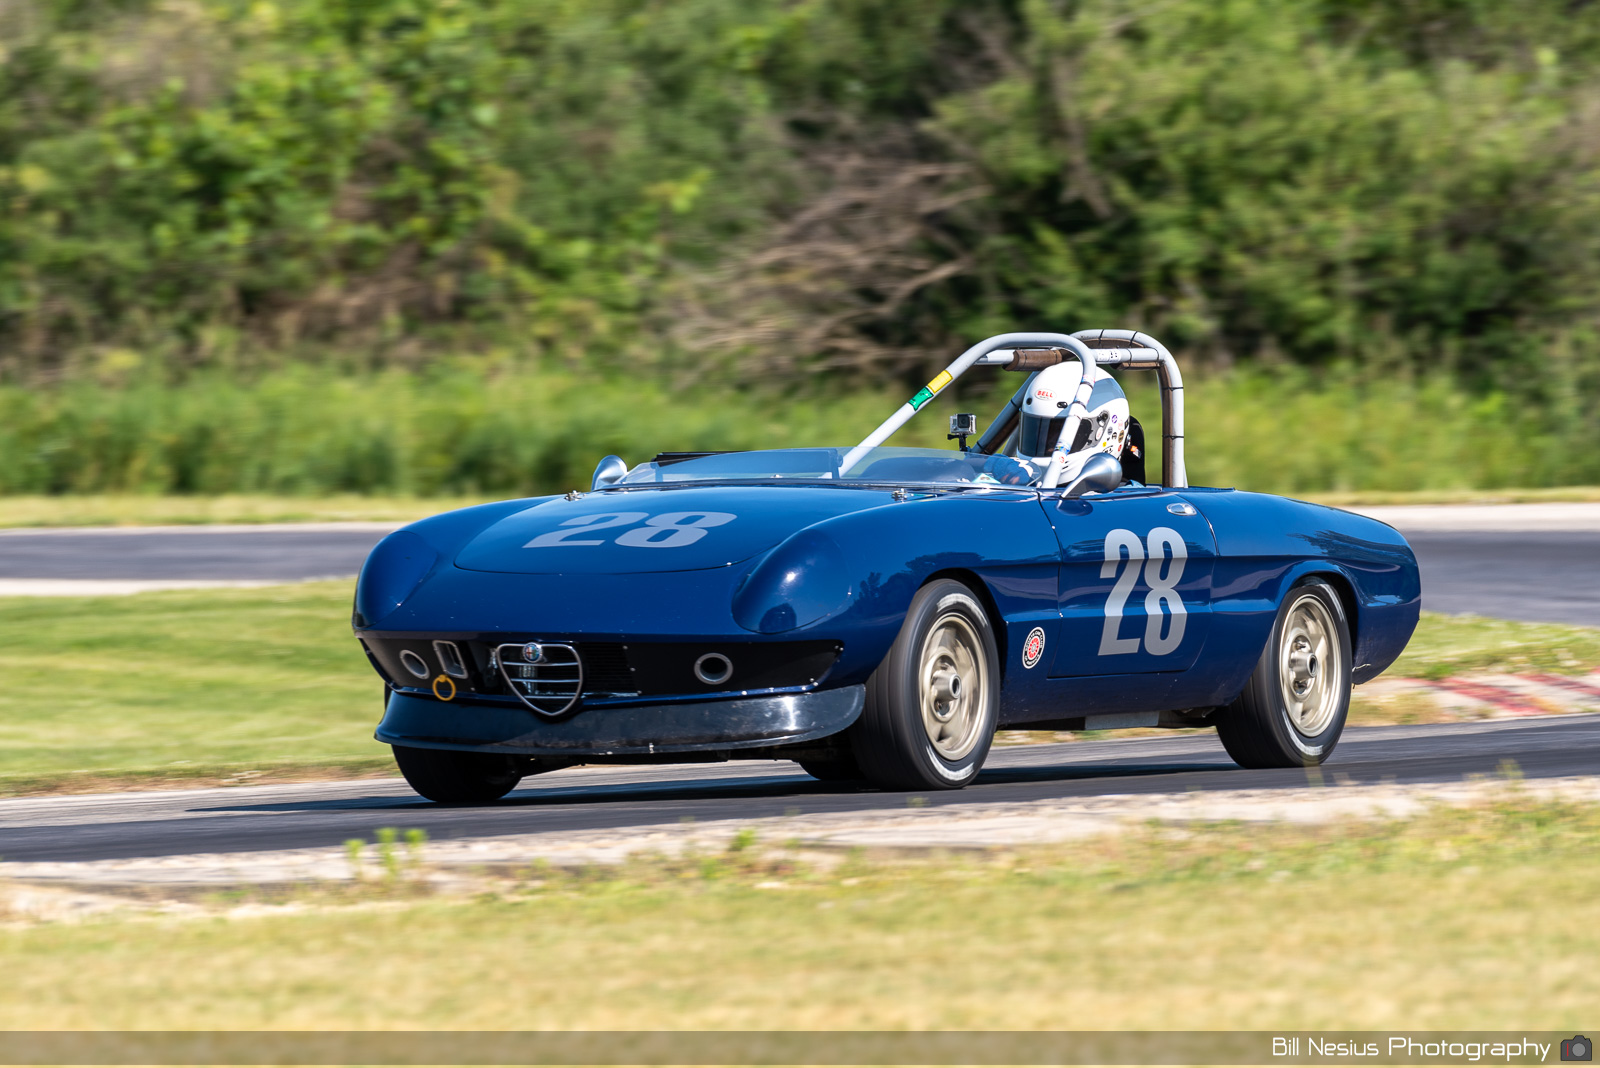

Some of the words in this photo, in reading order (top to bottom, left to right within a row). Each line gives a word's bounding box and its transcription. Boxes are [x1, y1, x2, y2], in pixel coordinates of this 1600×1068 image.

[1036, 390, 1053, 398] BELL
[521, 511, 738, 549] 28
[1097, 526, 1188, 656] 28
